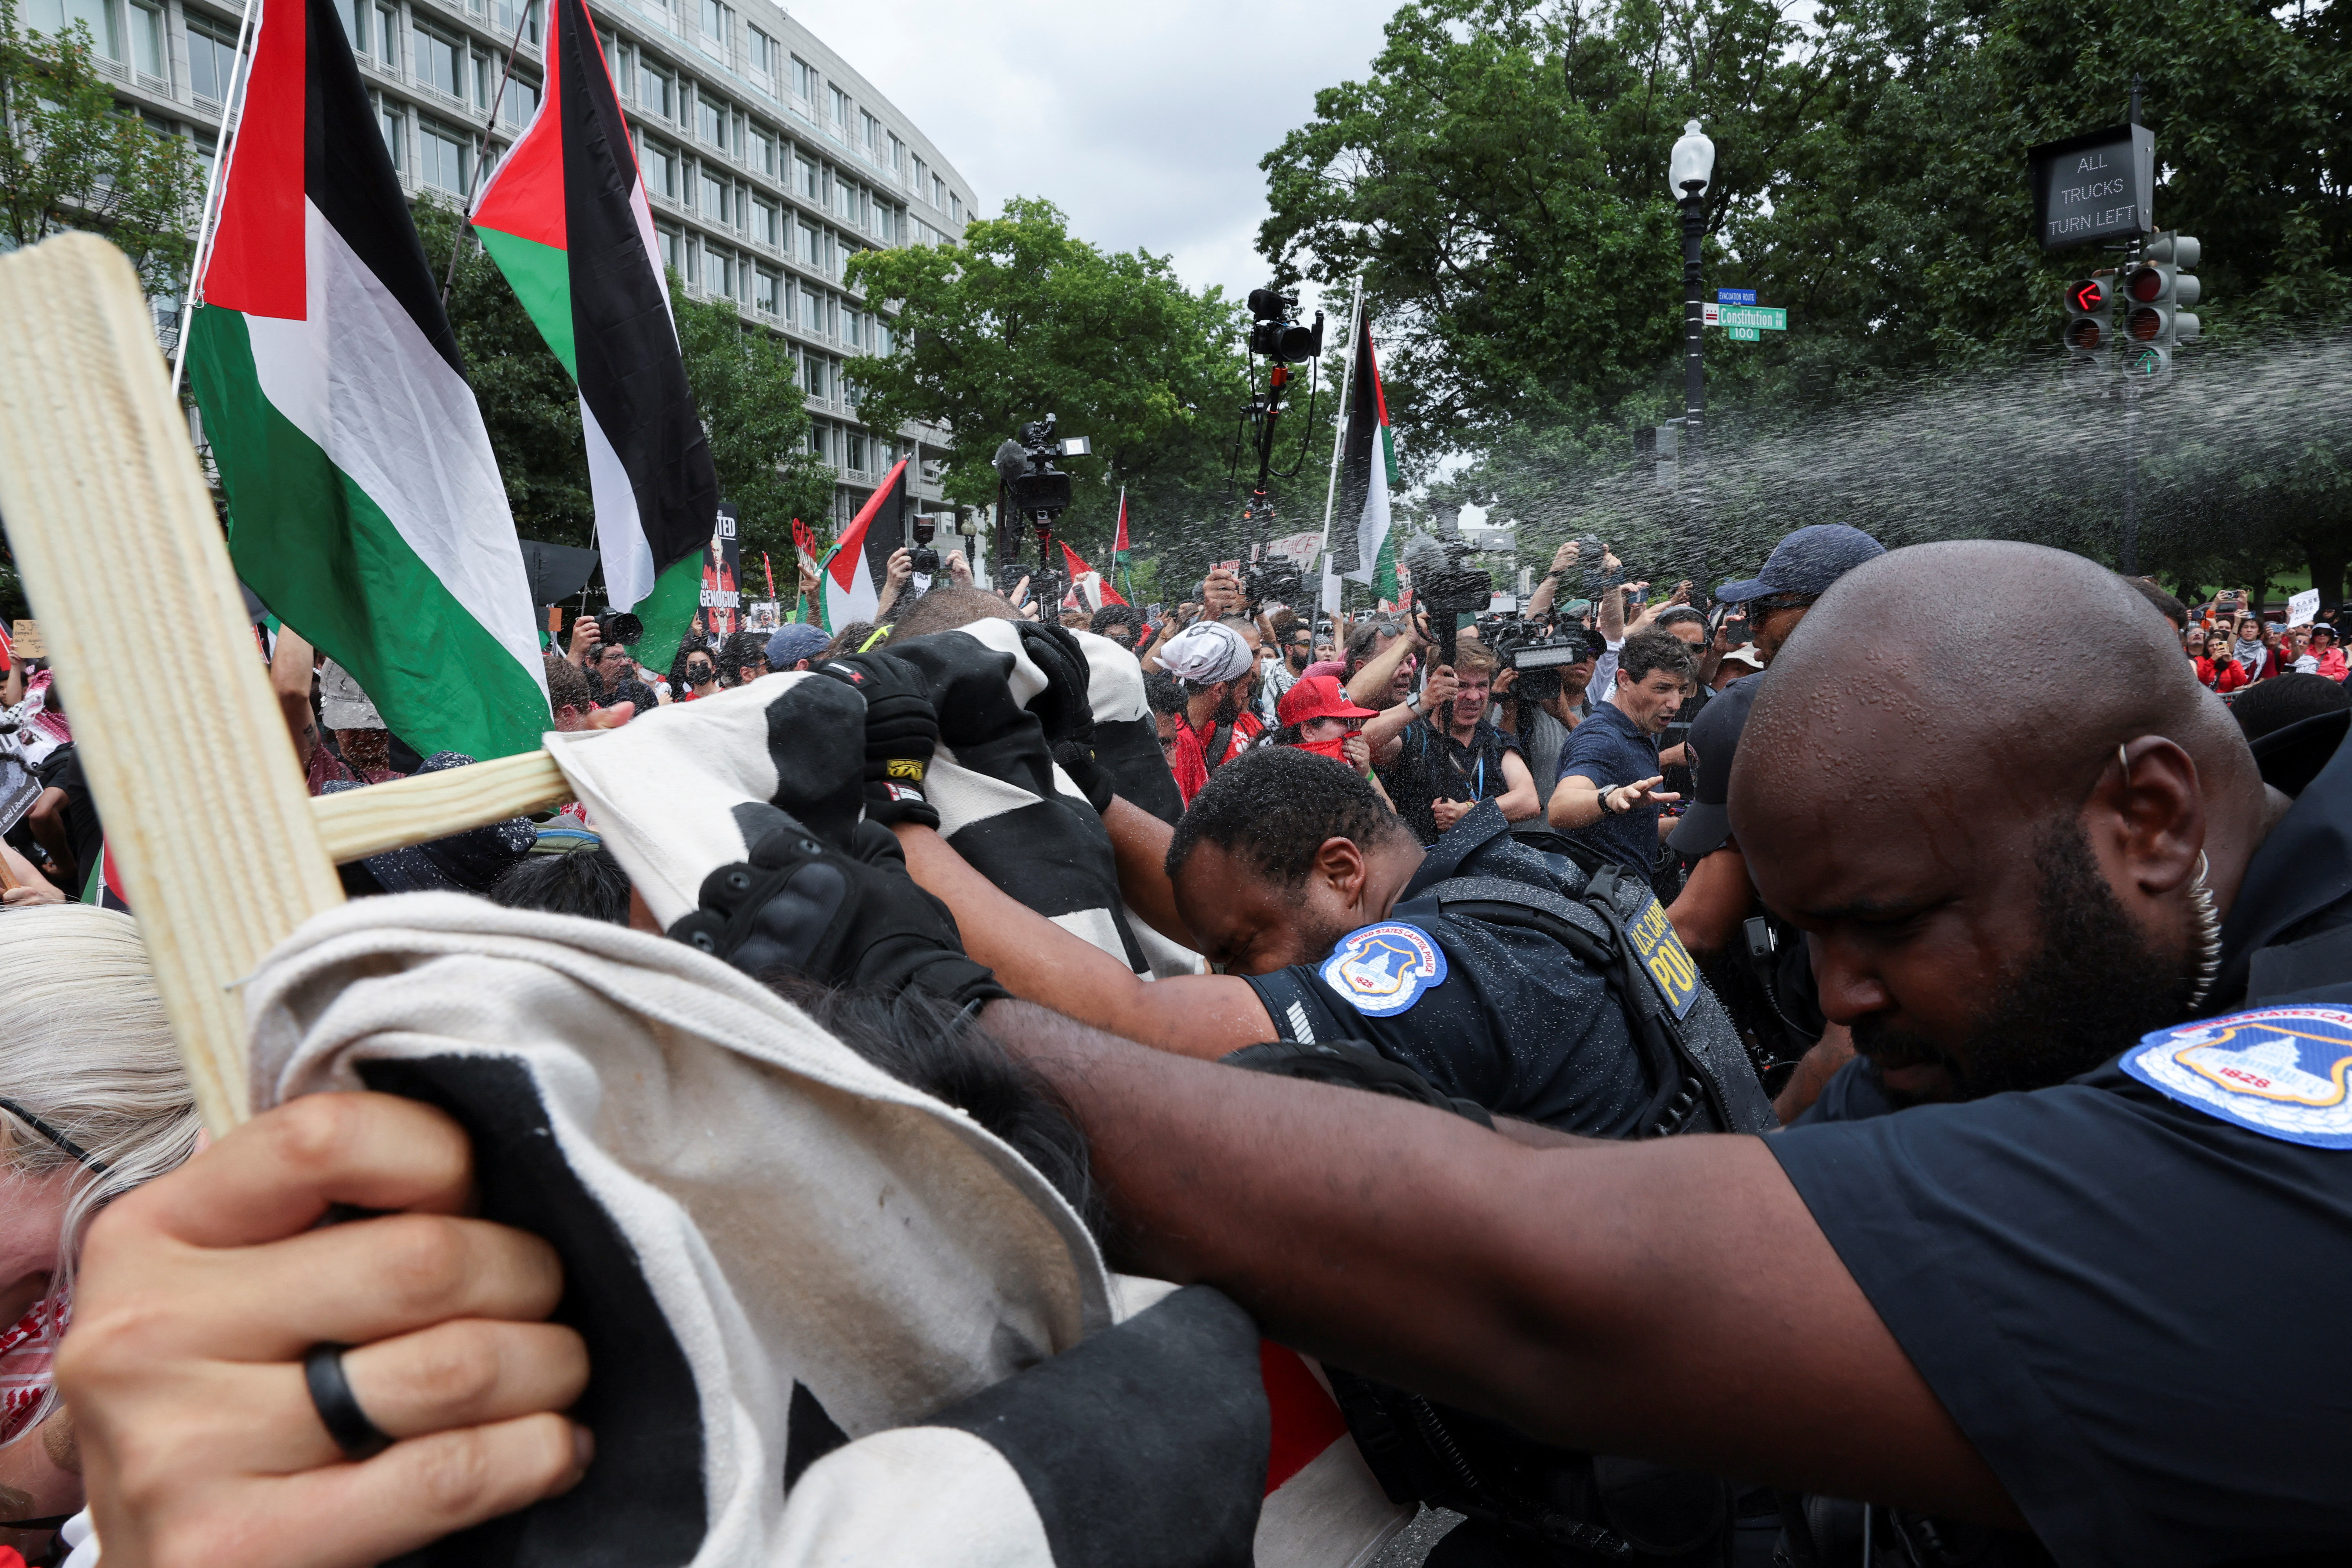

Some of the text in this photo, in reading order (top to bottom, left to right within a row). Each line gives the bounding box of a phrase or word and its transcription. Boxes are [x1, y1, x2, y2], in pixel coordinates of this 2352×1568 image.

[2077, 154, 2107, 173] ALL
[2062, 178, 2123, 203] TRUCKS
[2049, 205, 2135, 235] TURN LEFT
[1719, 292, 1755, 301] EVACUATION ROUTE
[1721, 307, 1773, 327] Constitution
[1735, 328, 1753, 339] 100
[715, 516, 736, 537] TED
[1211, 561, 1240, 571] WNTED
[700, 589, 740, 608] GENOCIDE
[2291, 597, 2318, 608] CEASE
[2296, 606, 2313, 614] FIRE
[2, 785, 37, 823] and Liberation
[1348, 931, 1374, 945] UNITED
[1403, 931, 1428, 953] CAPITOL
[1425, 951, 1434, 974] POLICE
[1355, 976, 1374, 988] 1828
[2219, 1067, 2272, 1089] 1828
